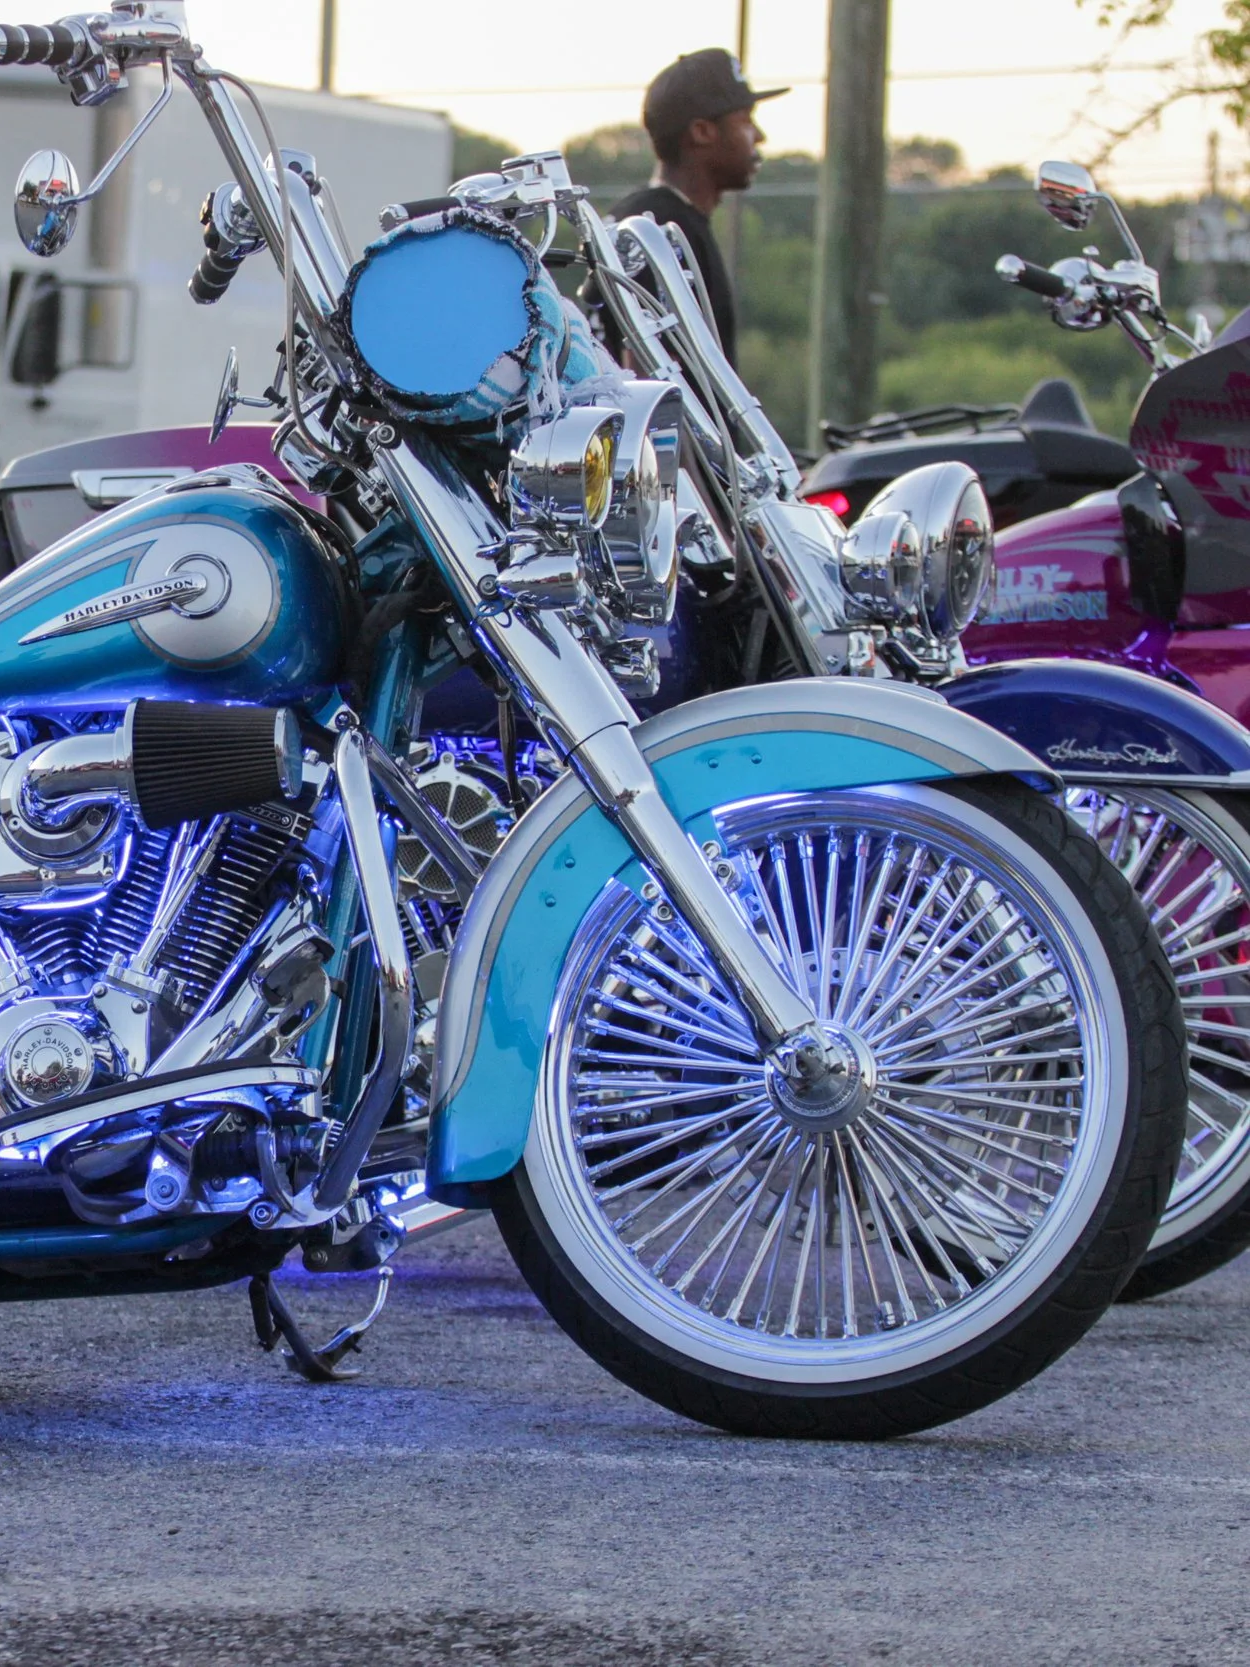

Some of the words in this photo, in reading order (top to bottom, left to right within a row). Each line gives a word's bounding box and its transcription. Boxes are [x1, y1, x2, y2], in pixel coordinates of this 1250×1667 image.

[996, 564, 1074, 595] LEY-
[64, 577, 193, 623] HARLEY-DAVIDSON
[980, 590, 1108, 625] AVIDSON
[23, 1037, 74, 1070] HARLEY-DAVIDSON
